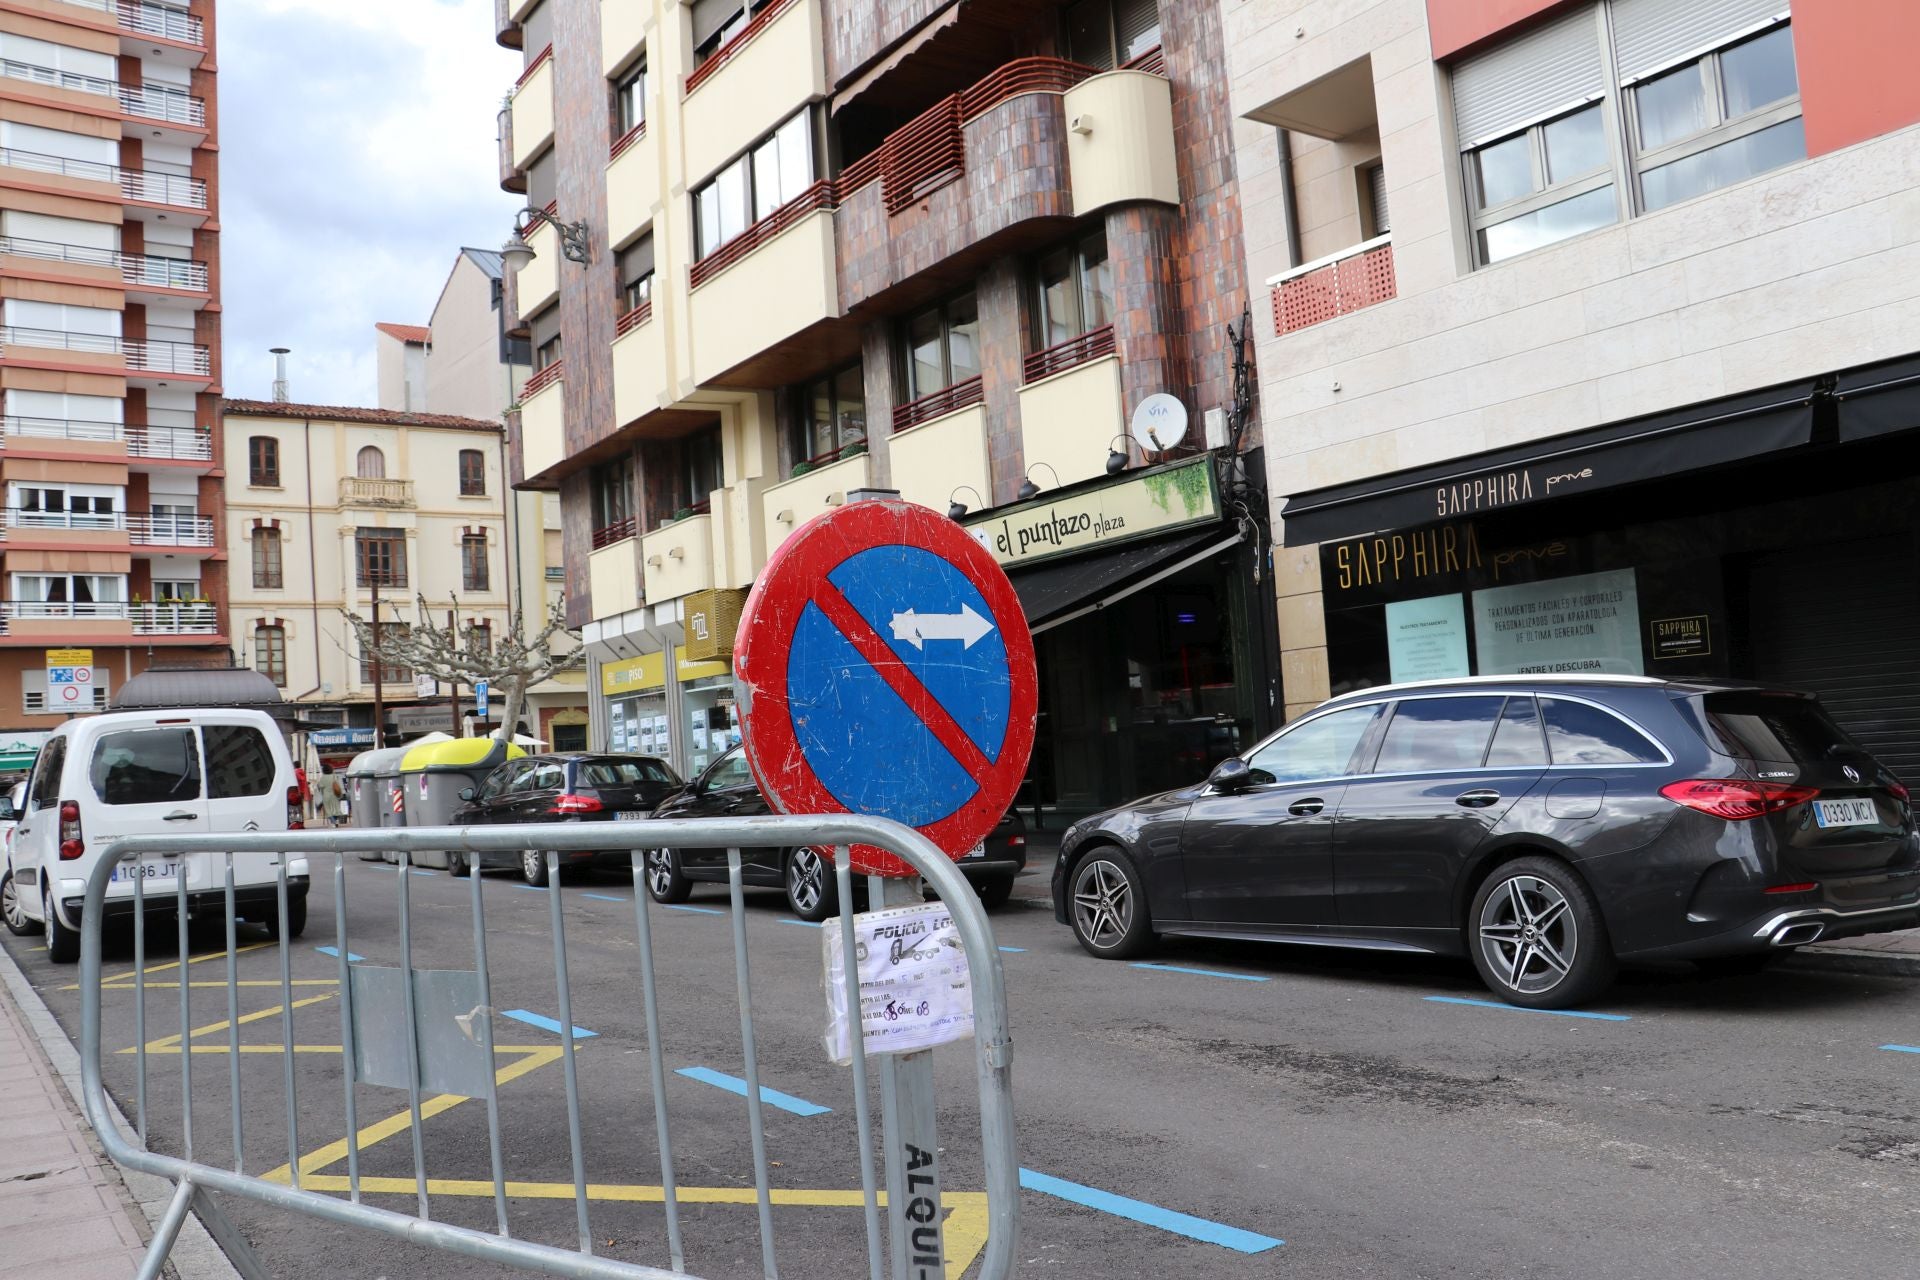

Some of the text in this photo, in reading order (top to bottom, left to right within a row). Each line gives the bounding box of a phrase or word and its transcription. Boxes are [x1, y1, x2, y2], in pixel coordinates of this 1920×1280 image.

[1437, 470, 1532, 516] SAPPHIRA
[997, 508, 1125, 556] el puntazo plaza
[1338, 523, 1482, 589] SAPPHIRA
[1488, 603, 1536, 618] TRATAMIENTOS
[1538, 598, 1569, 612] FACIALES
[1579, 591, 1623, 606] CORPORALES
[1494, 616, 1548, 632] PERSONALIZADOS
[1552, 613, 1565, 625] CON
[1659, 620, 1700, 636] SAPPHIRA
[1516, 633, 1524, 643] DE
[1556, 660, 1601, 673] DESCUBRA
[619, 811, 640, 820] 7393
[1823, 802, 1875, 823] 0330 MCX
[161, 863, 181, 877] JT
[916, 1001, 929, 1016] 08
